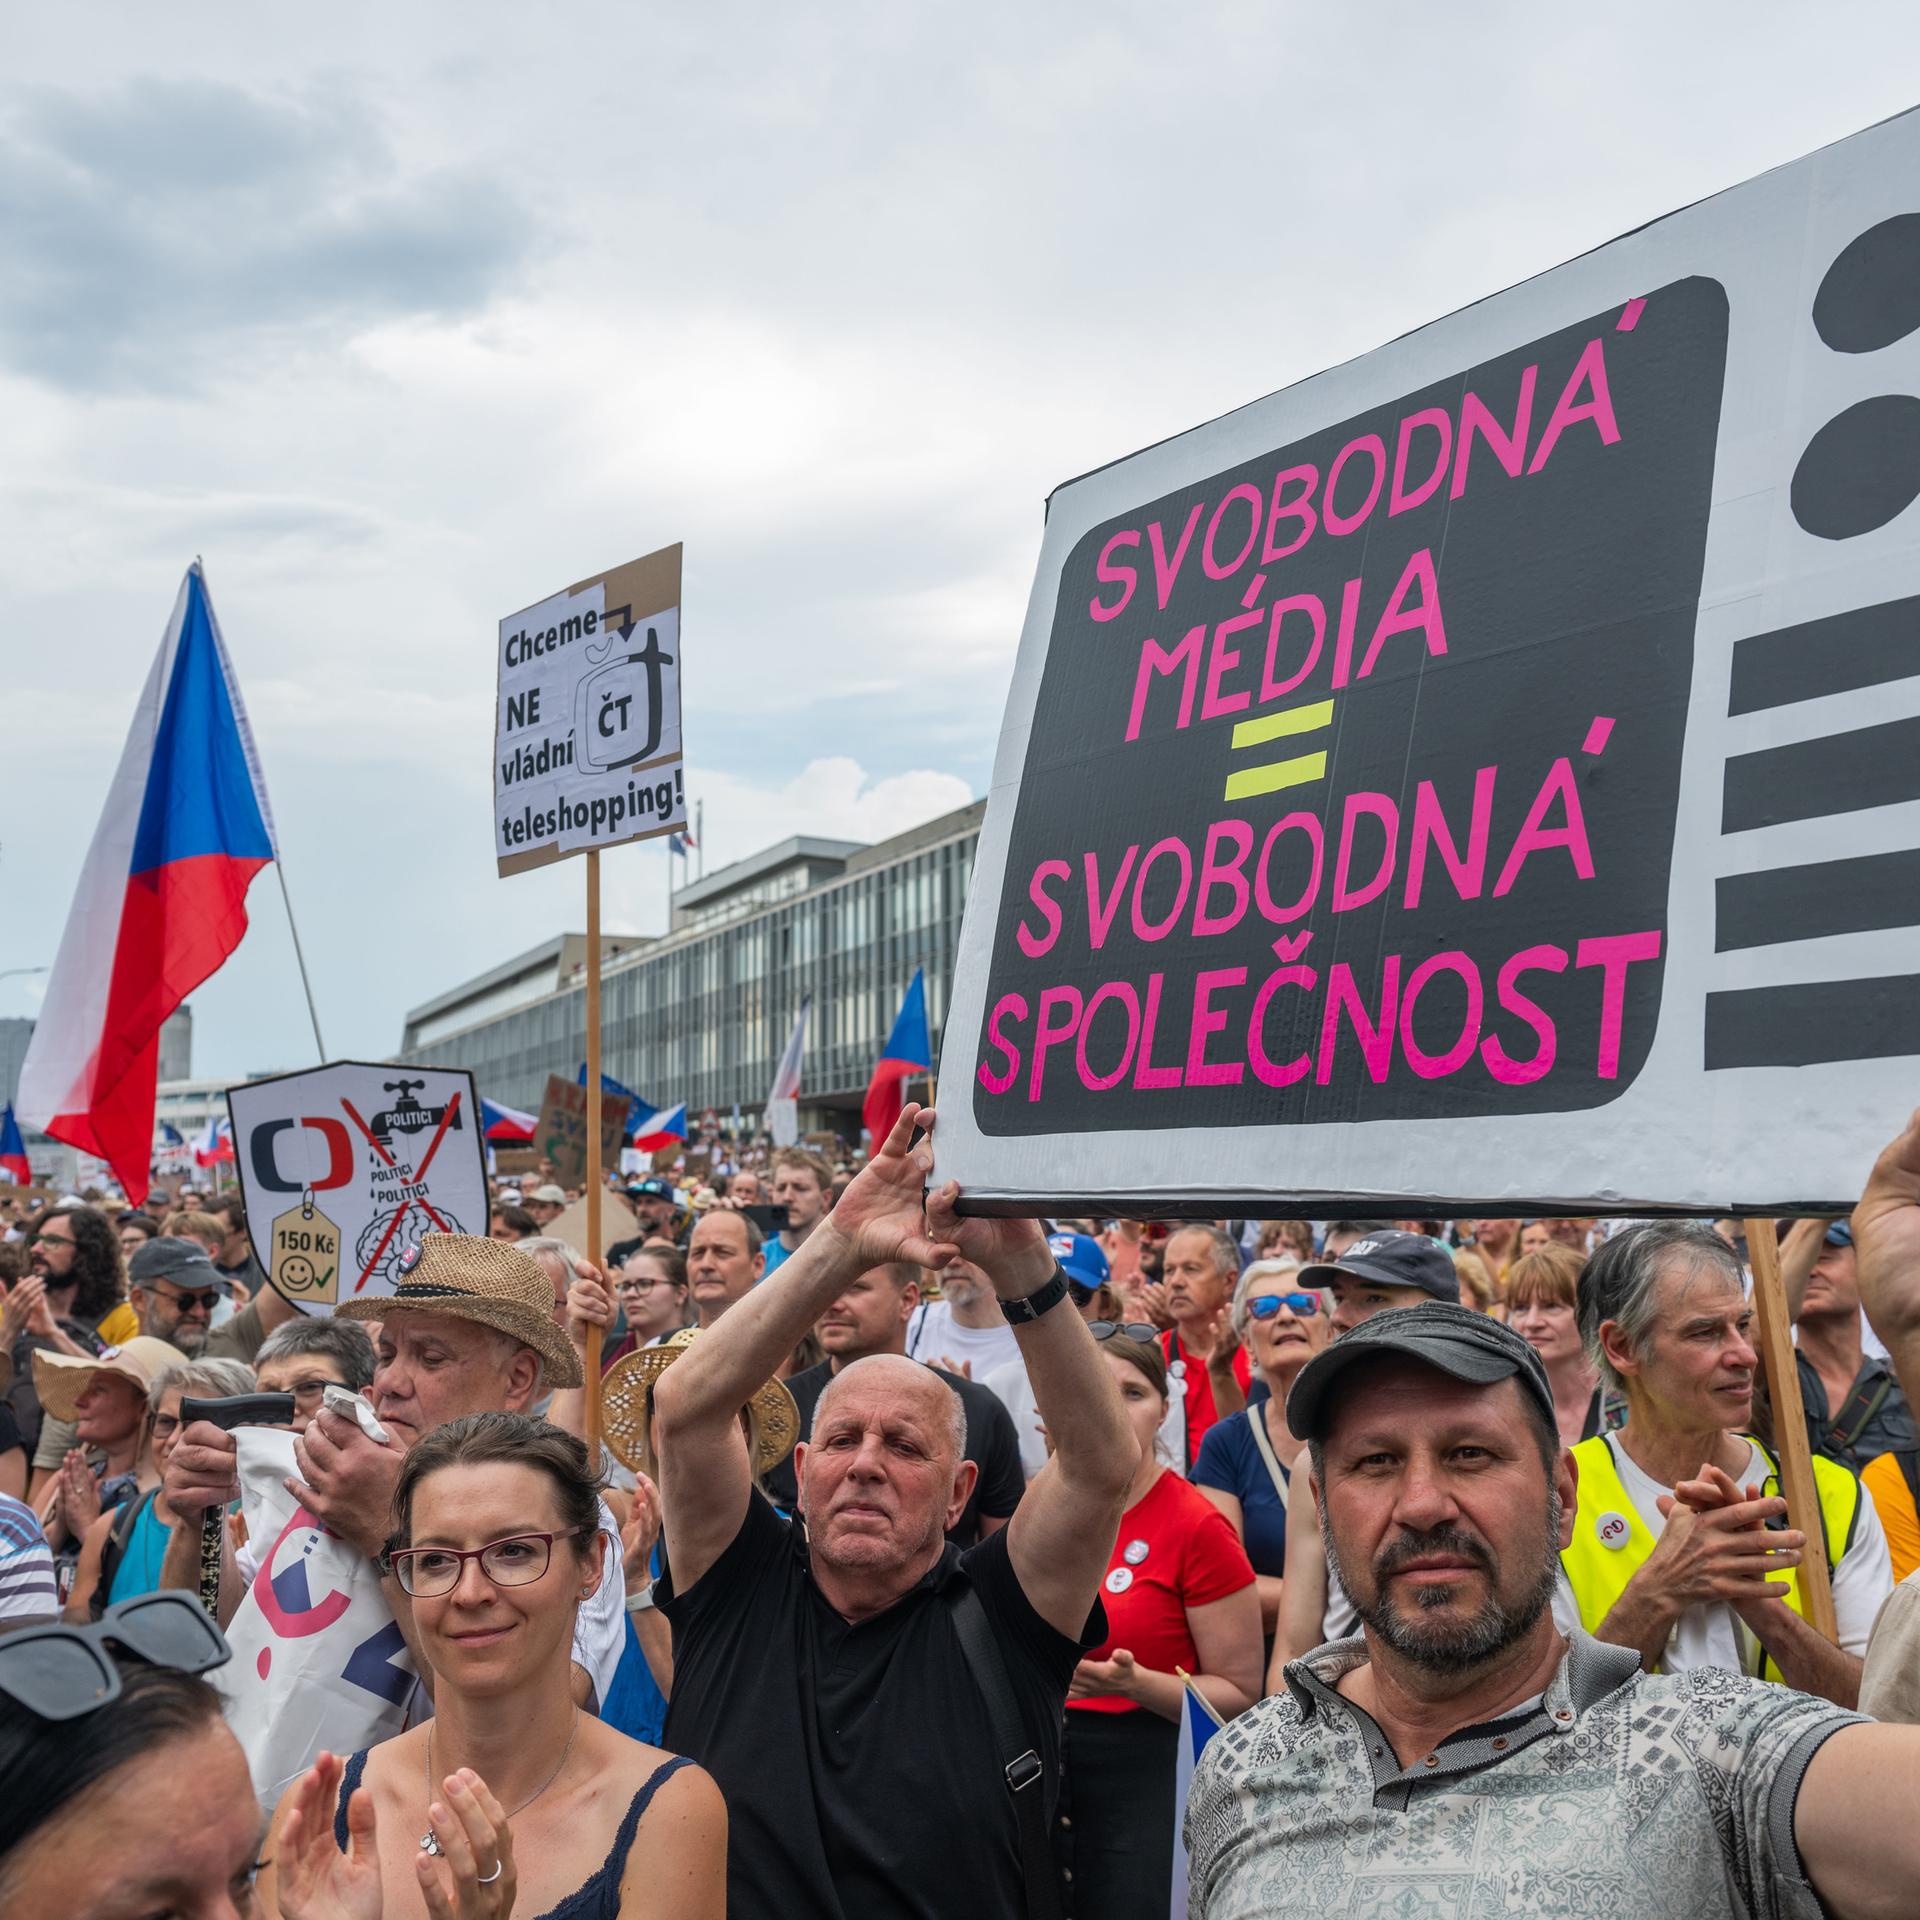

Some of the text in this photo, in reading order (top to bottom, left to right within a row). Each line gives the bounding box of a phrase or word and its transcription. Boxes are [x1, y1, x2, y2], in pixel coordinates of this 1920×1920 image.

[1089, 298, 1648, 623] SVOBODNÁ
[504, 609, 598, 669] Chceme
[1125, 547, 1449, 743] MÉDIA
[506, 687, 541, 732] NE
[597, 691, 633, 738] ČT
[501, 728, 575, 786] vládní
[501, 768, 684, 847] teleshopping!
[1016, 715, 1616, 958] SVOBODNÁ
[977, 929, 1662, 1102] SPOLEČNOST
[384, 1110, 433, 1128] POLITICI
[370, 1163, 414, 1183] POLITICI
[377, 1182, 431, 1204] POLITICI
[278, 1230, 335, 1254] 150 Kč
